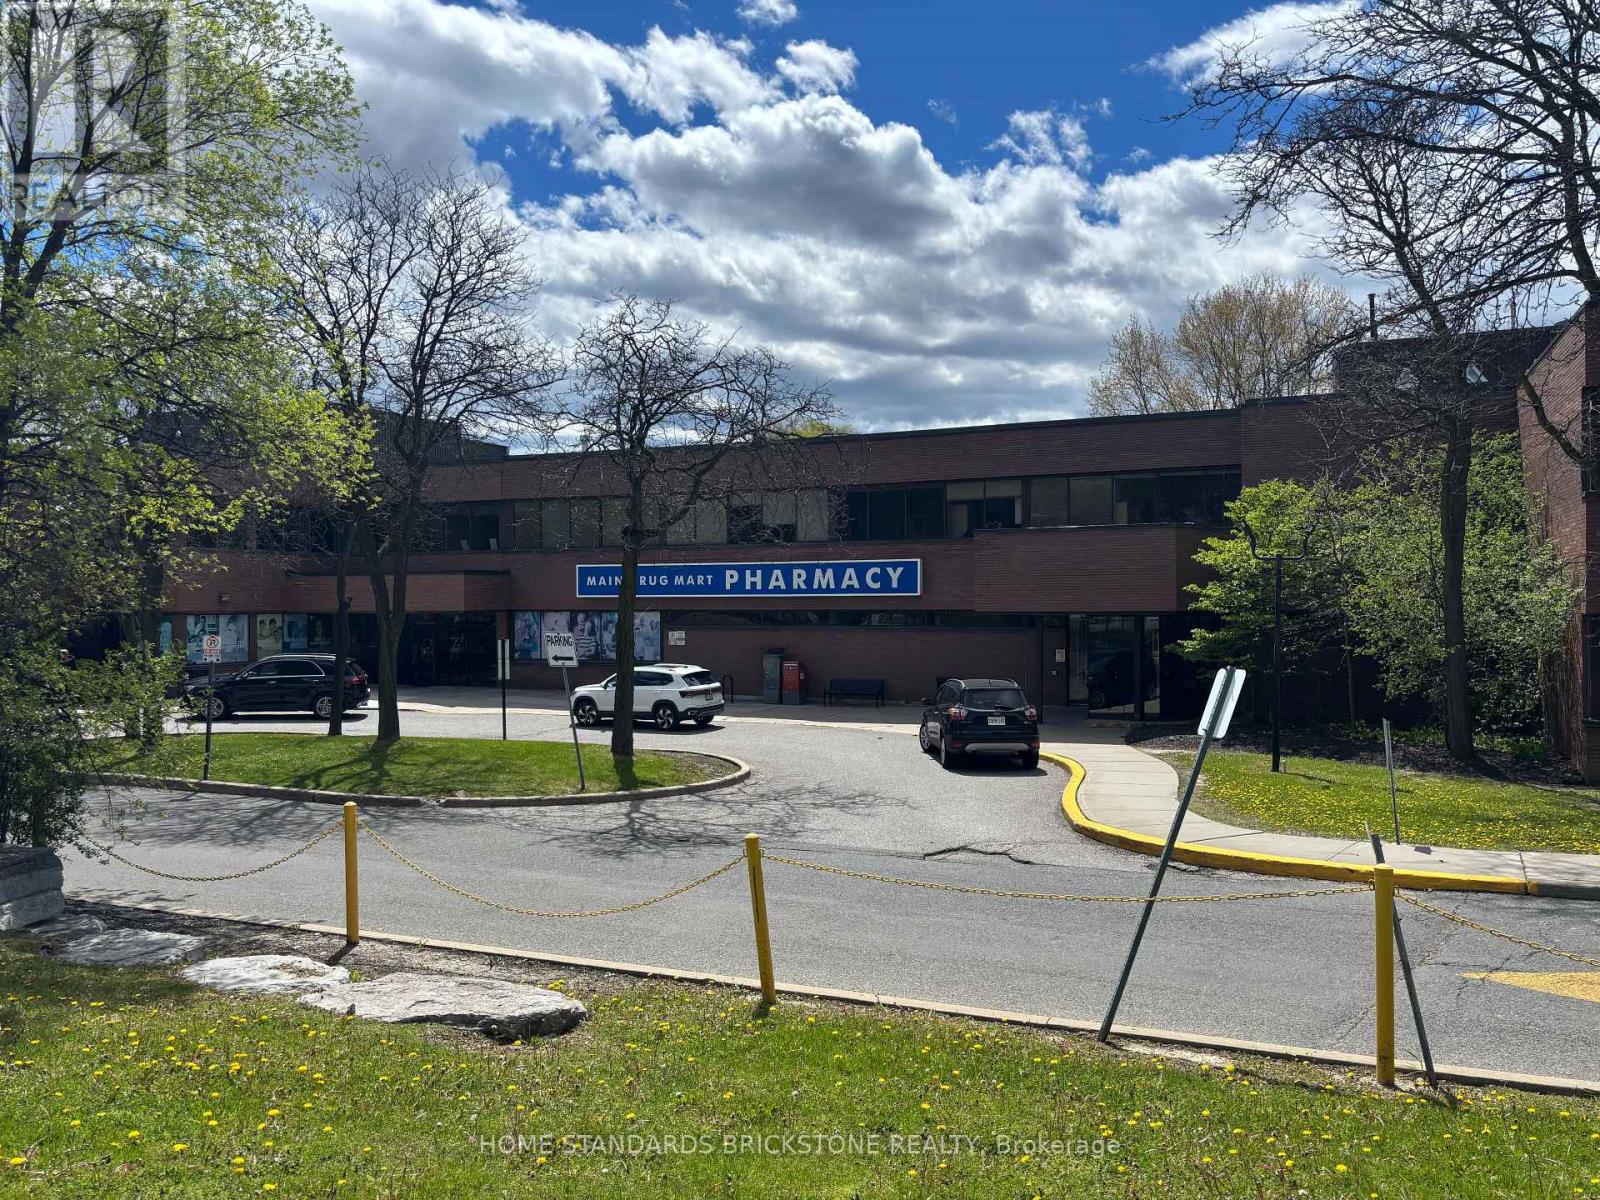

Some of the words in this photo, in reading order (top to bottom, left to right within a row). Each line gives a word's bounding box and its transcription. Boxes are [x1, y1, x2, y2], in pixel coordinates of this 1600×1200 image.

[586, 575, 623, 586] MAIN
[639, 575, 669, 586] RUG
[674, 575, 713, 586] MART
[725, 567, 905, 590] PHARMACY
[546, 635, 573, 647] PARKING
